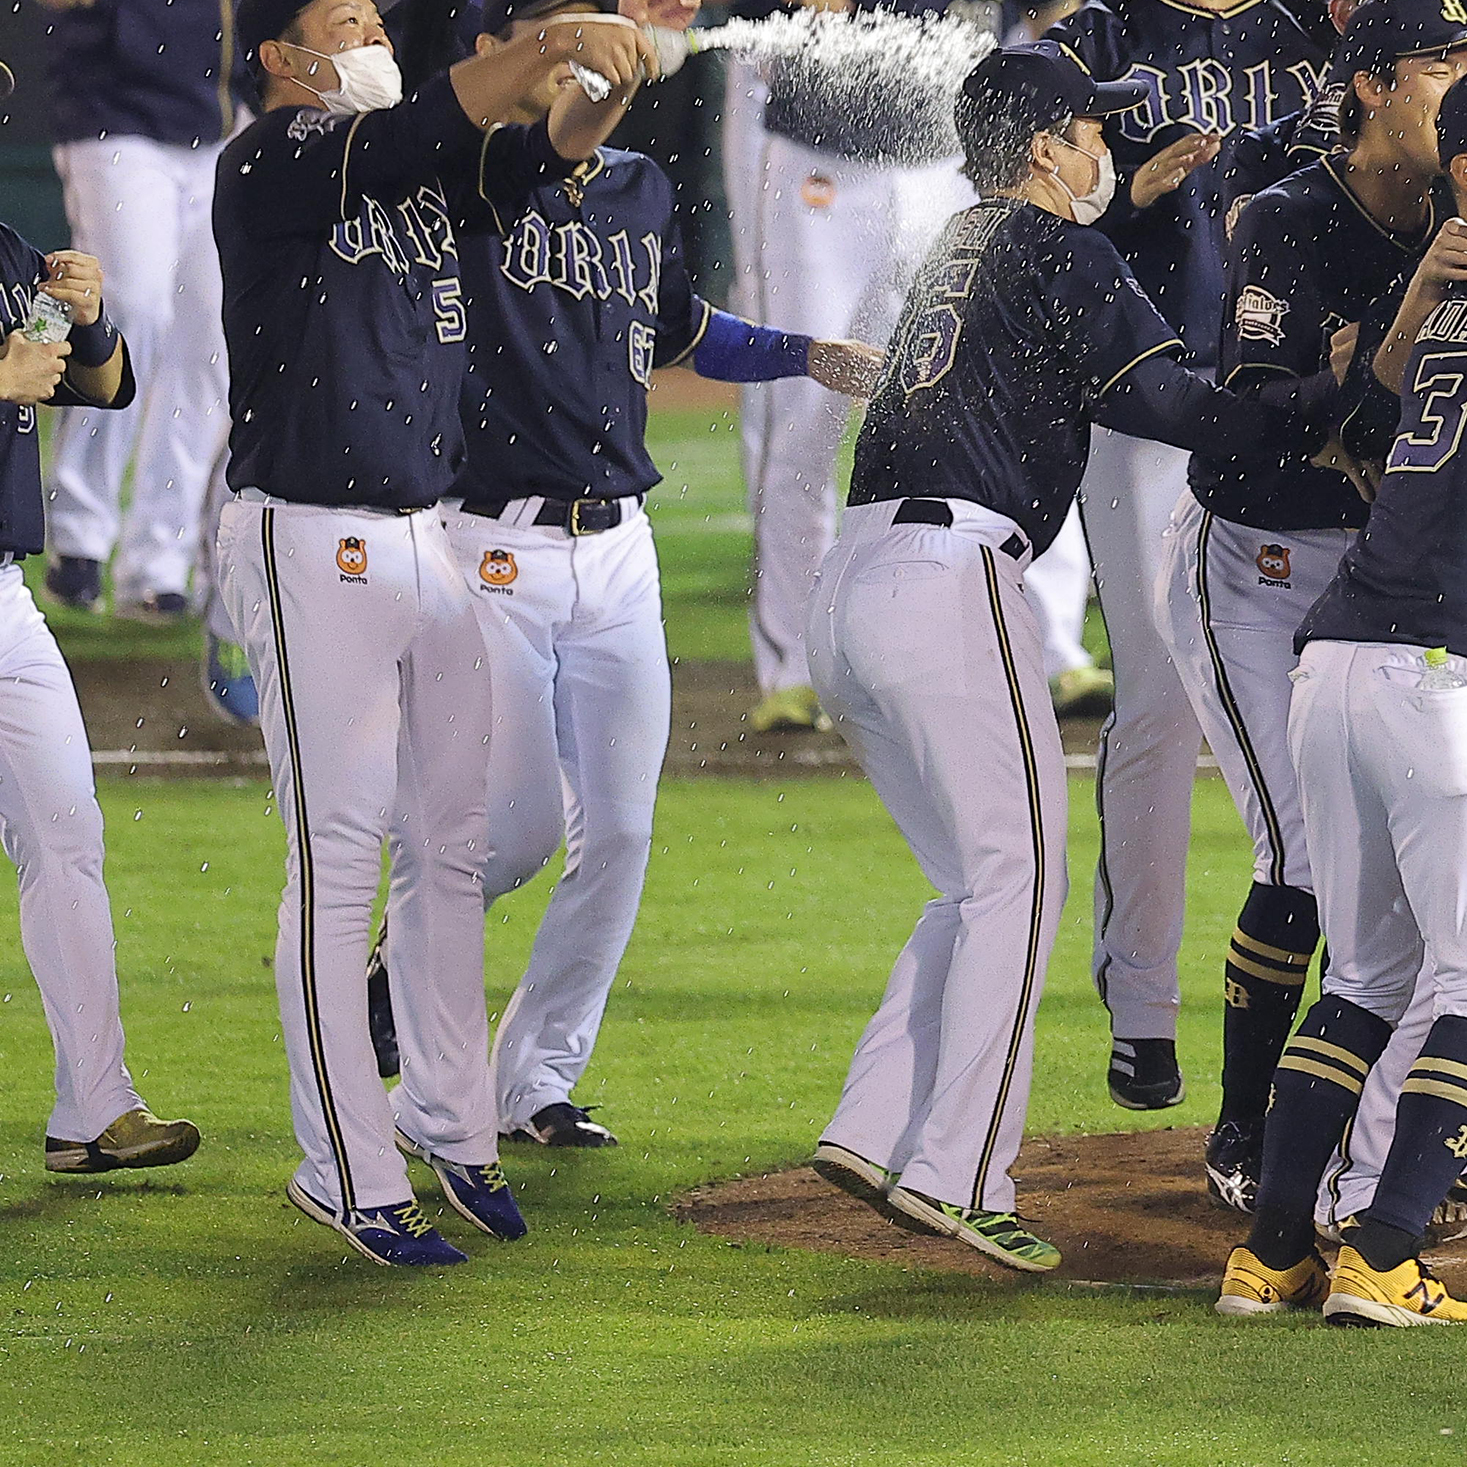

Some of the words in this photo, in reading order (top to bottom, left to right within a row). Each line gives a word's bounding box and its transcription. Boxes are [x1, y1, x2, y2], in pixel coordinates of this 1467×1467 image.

[338, 574, 369, 587] Ponta
[1258, 577, 1292, 591] Ponta
[479, 582, 515, 596] Ponta
